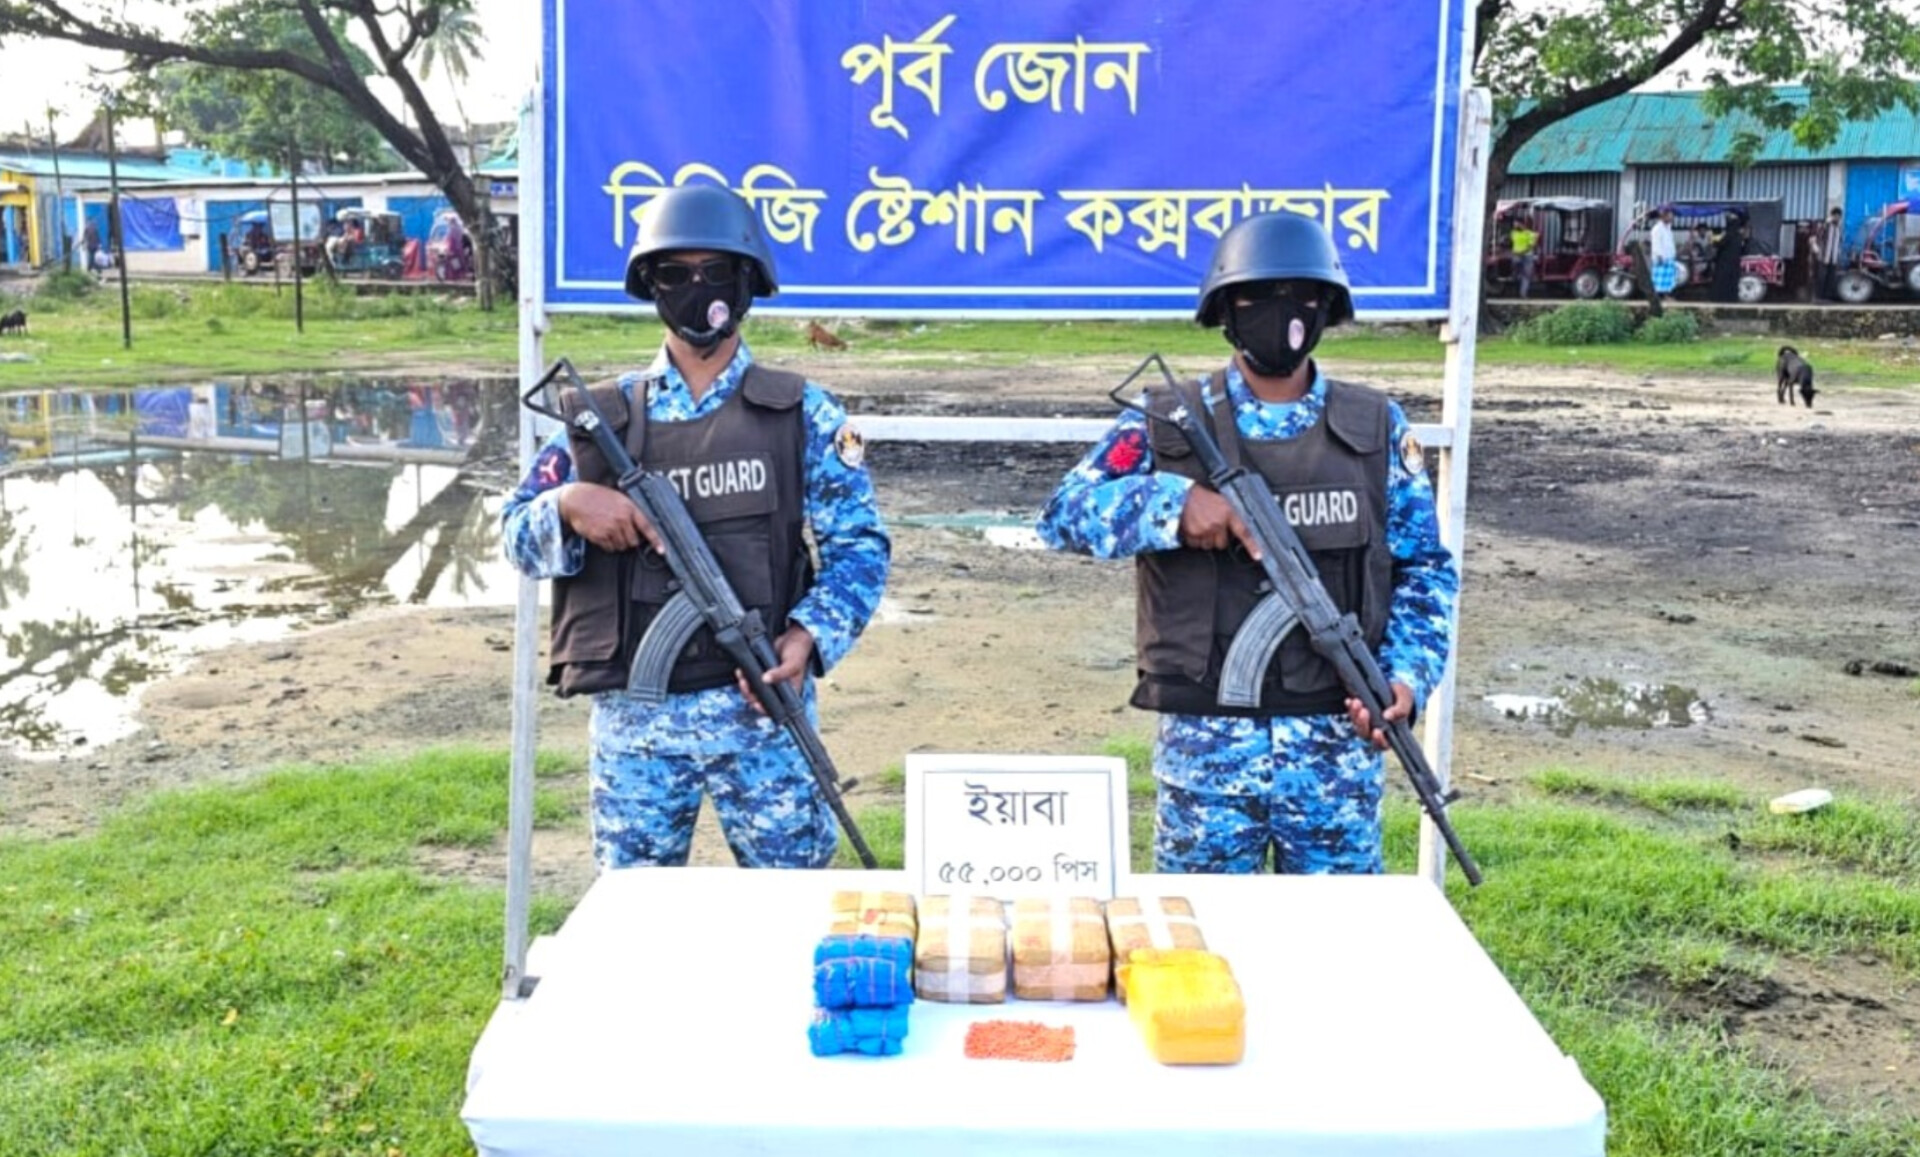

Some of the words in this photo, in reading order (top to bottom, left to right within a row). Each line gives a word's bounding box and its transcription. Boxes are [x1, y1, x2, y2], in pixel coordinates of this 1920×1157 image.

[840, 14, 958, 139] পূর্ব
[974, 35, 1151, 116] জোন
[845, 166, 1044, 256] ষ্টেশান
[695, 459, 766, 498] GUARD
[1284, 490, 1358, 526] GUARD
[964, 780, 1069, 826] ইয়াবা
[1053, 852, 1098, 882] পিস
